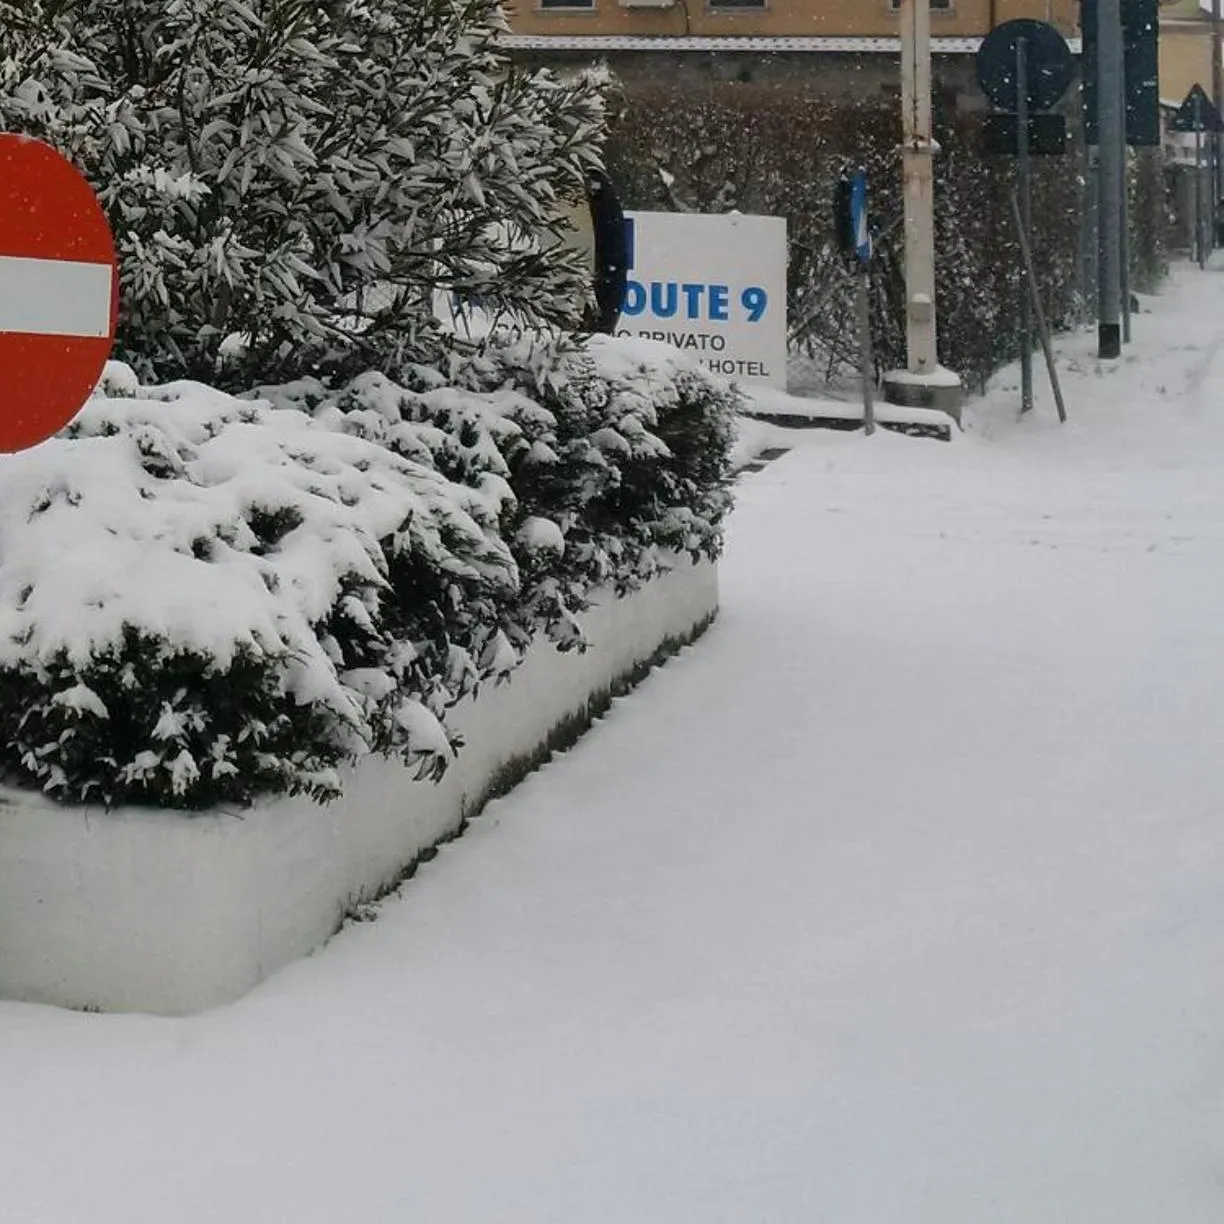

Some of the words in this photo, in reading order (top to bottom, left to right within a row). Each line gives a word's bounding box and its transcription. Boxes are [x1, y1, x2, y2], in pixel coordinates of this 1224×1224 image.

[622, 280, 729, 321] OUTE
[741, 286, 768, 322] 9
[709, 359, 770, 377] HOTEL
